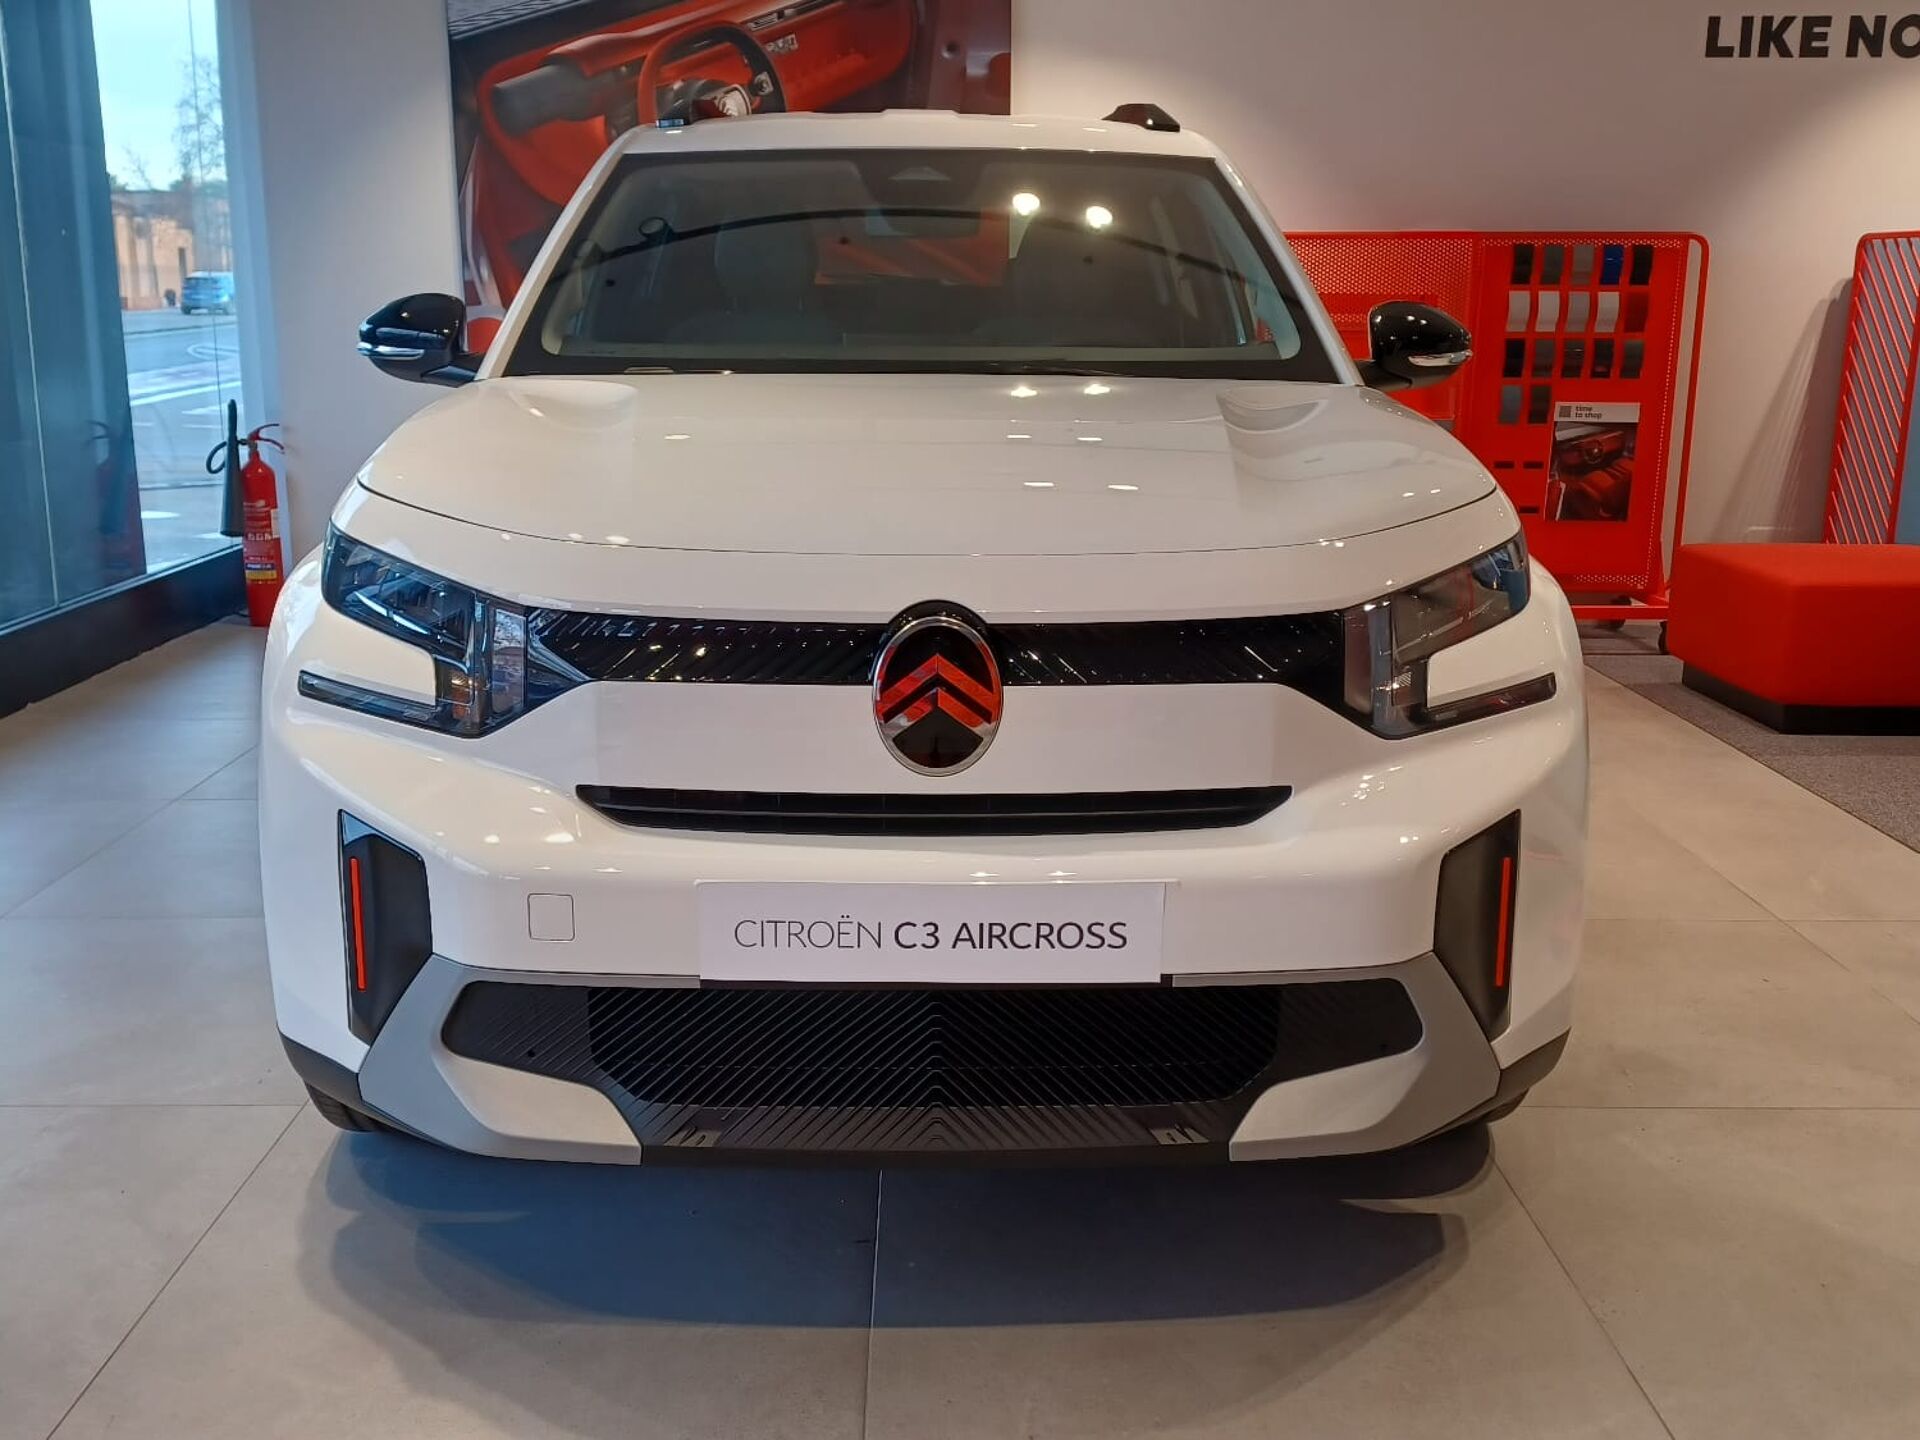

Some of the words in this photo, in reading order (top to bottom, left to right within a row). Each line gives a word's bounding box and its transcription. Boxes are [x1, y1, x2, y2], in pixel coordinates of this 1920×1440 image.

[1705, 16, 1833, 59] LIKE
[1845, 14, 1920, 59] NO
[734, 914, 881, 950] CITROËN
[894, 921, 940, 950] C3
[951, 921, 1128, 950] AIRCROSS
